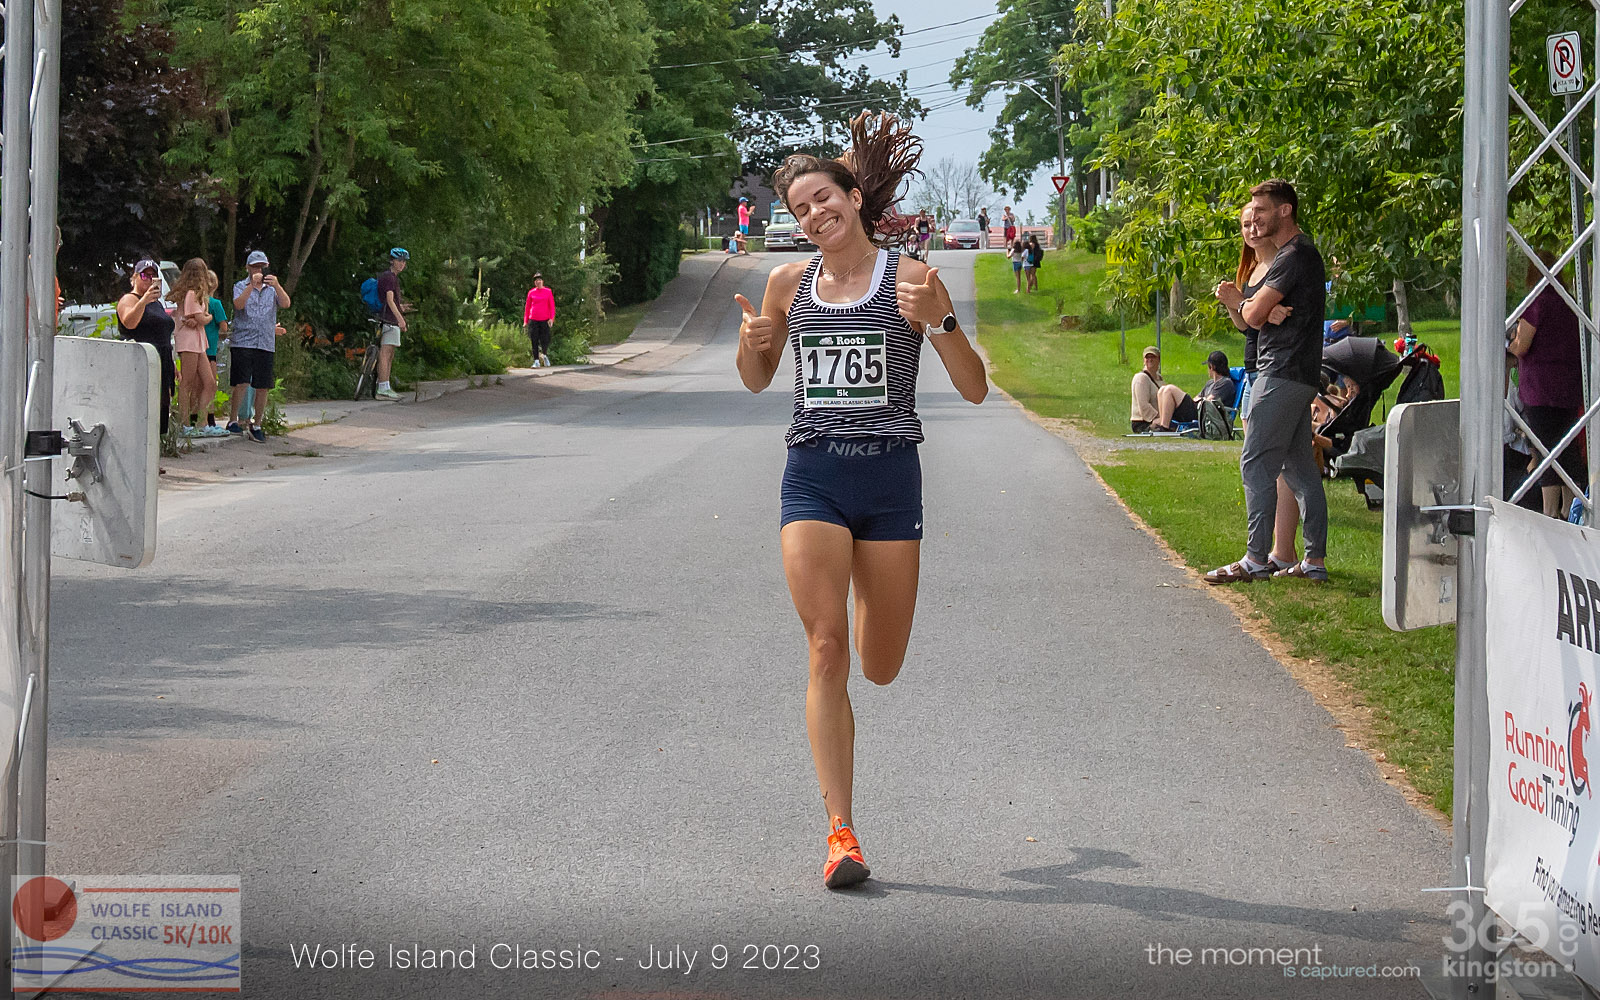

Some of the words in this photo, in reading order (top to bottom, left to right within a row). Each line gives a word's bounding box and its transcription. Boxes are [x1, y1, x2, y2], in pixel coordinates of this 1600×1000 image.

[836, 336, 866, 345] Roots
[807, 348, 883, 385] 1765
[836, 388, 849, 397] 5k
[827, 441, 881, 457] NIKE
[1504, 710, 1565, 787] Running
[1532, 855, 1551, 892] Find
[1556, 886, 1586, 935] amazing
